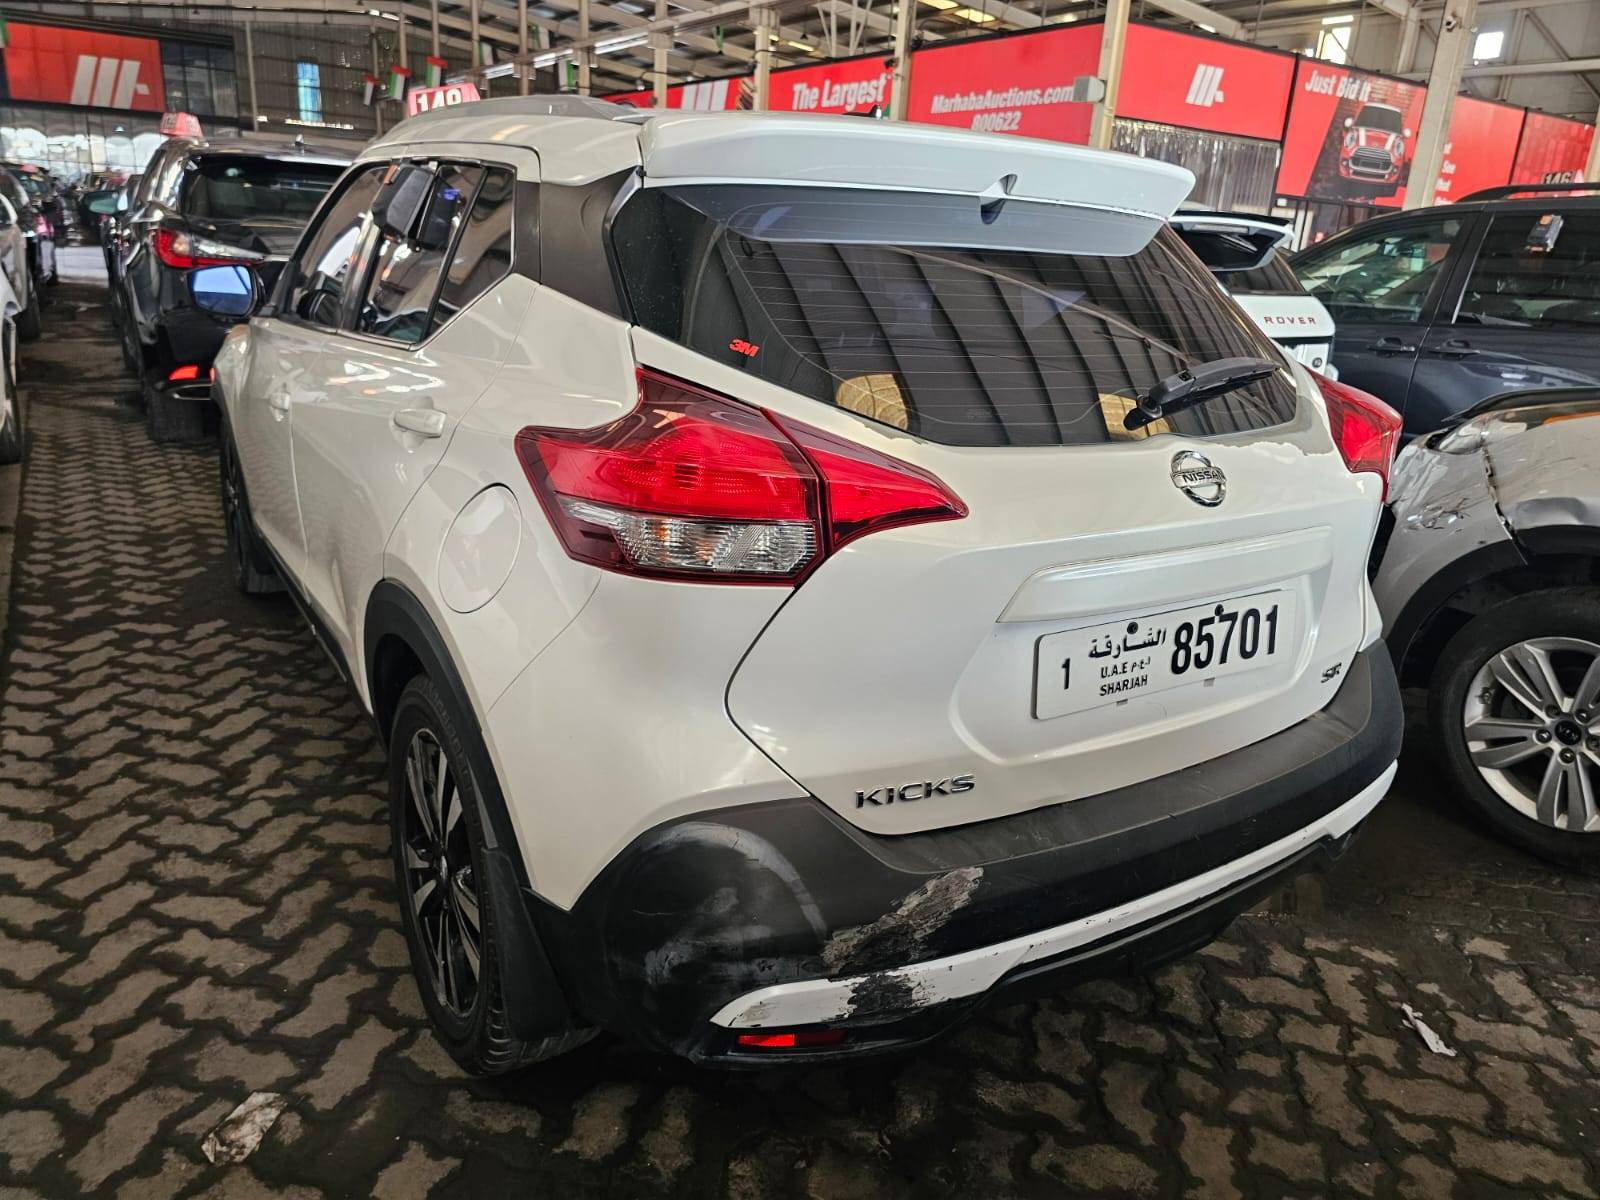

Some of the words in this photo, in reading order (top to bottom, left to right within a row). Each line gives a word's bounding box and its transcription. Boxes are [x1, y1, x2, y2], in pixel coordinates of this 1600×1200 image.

[792, 82, 819, 110] The
[821, 72, 887, 112] Largest
[931, 85, 1075, 114] MarhabaAuctions.com
[1305, 70, 1337, 96] Just
[1336, 75, 1361, 100] Bid
[1263, 316, 1316, 324] ROVER
[729, 338, 759, 357] 3M
[1088, 627, 1167, 660] الشارقة
[1170, 603, 1280, 676] 85701
[1061, 657, 1071, 691] 1
[1099, 674, 1148, 697] SHARJAH
[1100, 661, 1129, 680] U.A.E
[855, 773, 975, 809] KICKS
